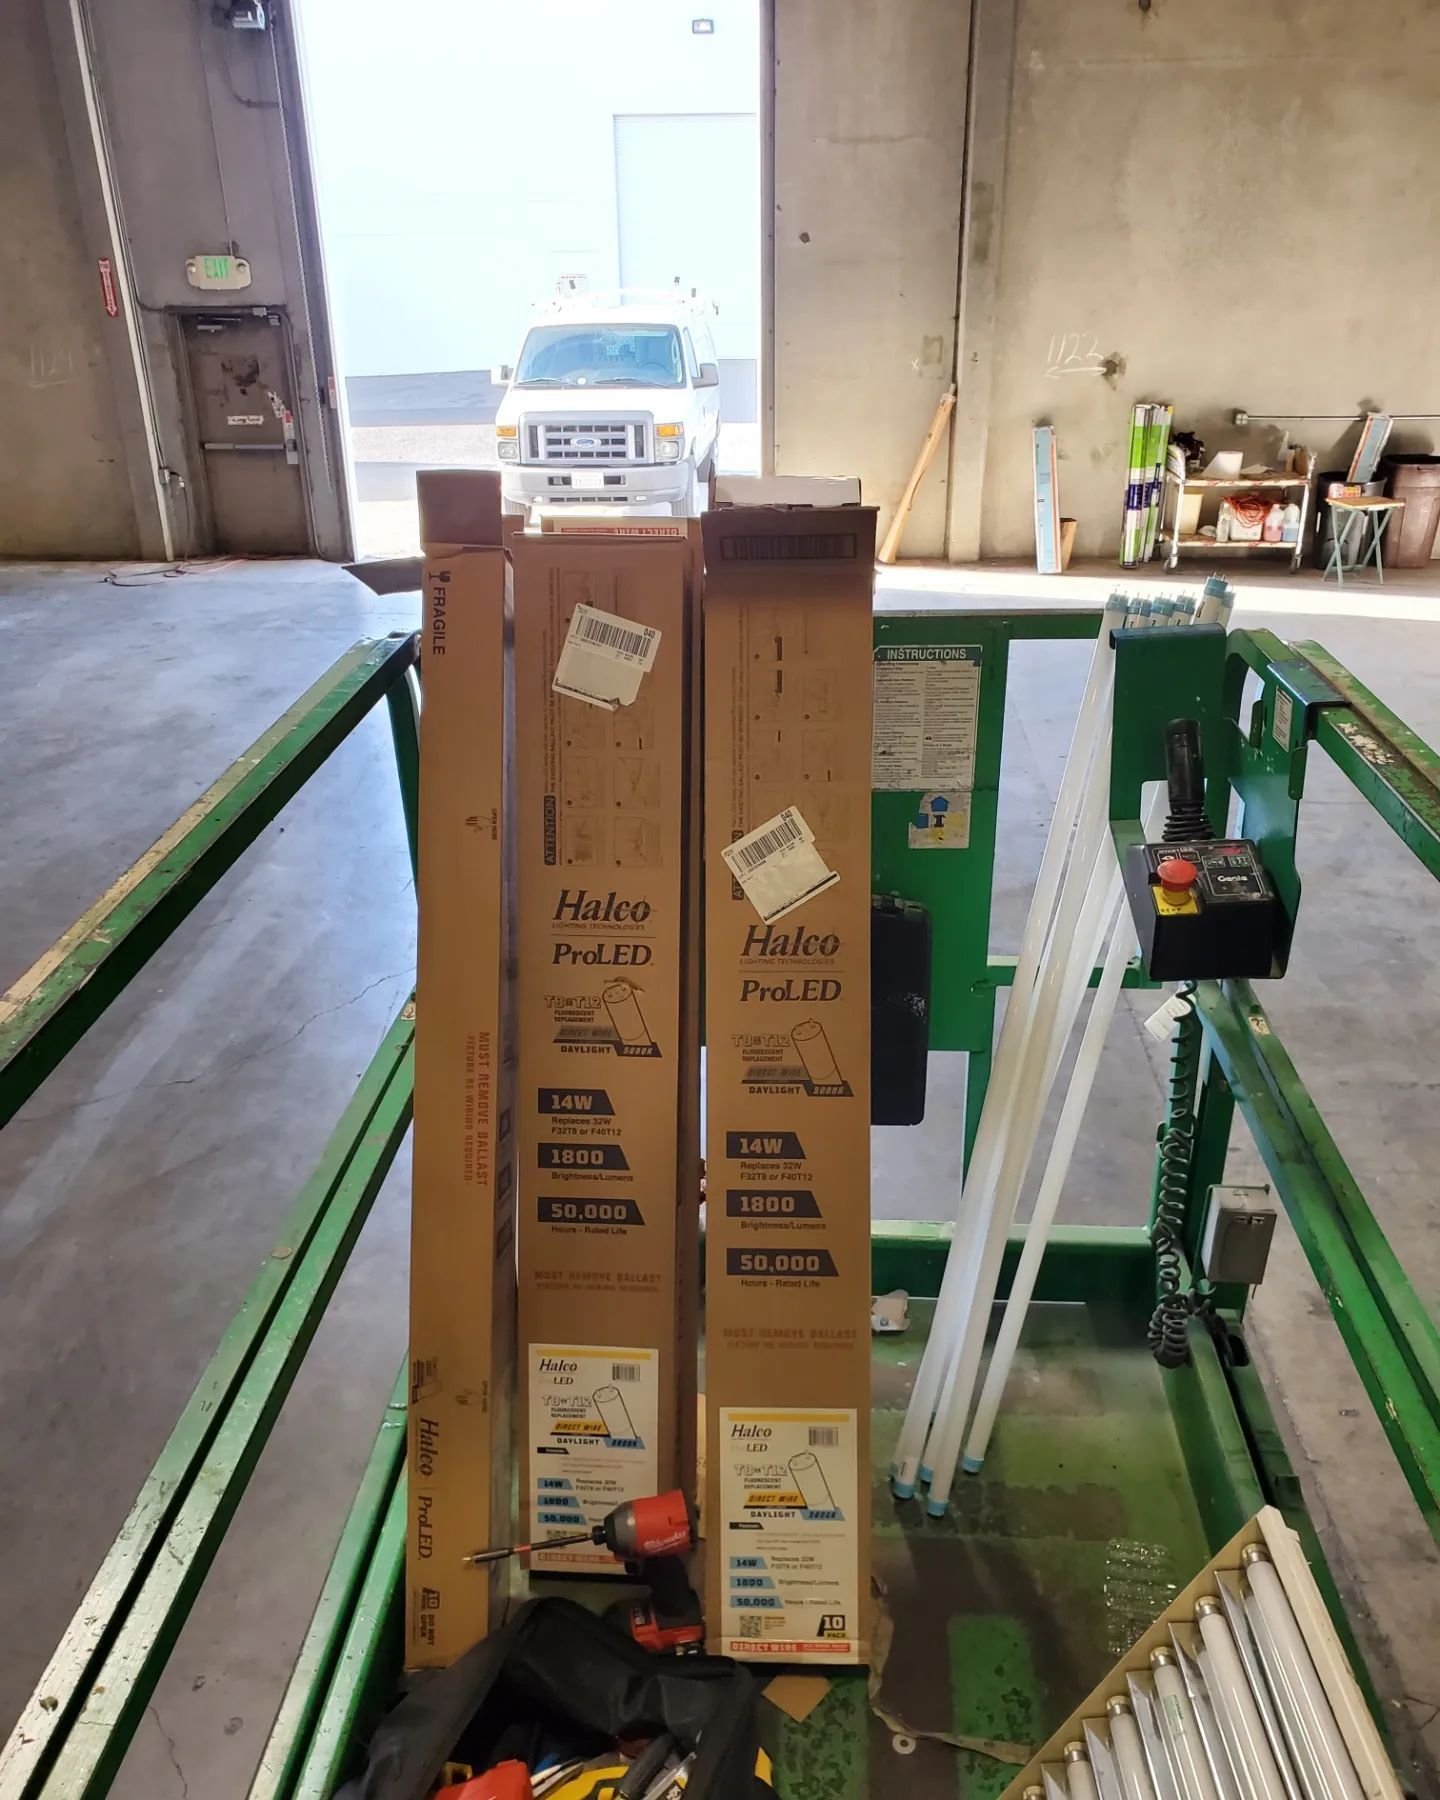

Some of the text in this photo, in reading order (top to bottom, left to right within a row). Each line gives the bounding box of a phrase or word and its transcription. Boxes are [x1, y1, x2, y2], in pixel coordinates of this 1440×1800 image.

[203, 257, 230, 279] EXIT
[1047, 331, 1104, 364] 1122
[432, 587, 446, 655] FRAGILE
[886, 648, 967, 660] INSTRUCTIONS
[545, 796, 555, 864] ATTENTION
[552, 889, 652, 922] Halco
[552, 922, 586, 930] LIGHTING
[740, 924, 840, 957] Halco
[552, 943, 652, 966] ProLED
[740, 979, 842, 1002] ProLED
[560, 1045, 612, 1054] DAYLIGHT
[748, 1086, 800, 1094] DAYLIGHT
[551, 1095, 593, 1110] 14W
[476, 1032, 490, 1186] MUST REMOVE BALLAST
[552, 1116, 612, 1126] Replaces 32W
[552, 1126, 577, 1135] F32T8
[591, 1128, 622, 1136] F40T12
[740, 1138, 782, 1154] 14W
[551, 1149, 604, 1165] 1800
[740, 1161, 780, 1171] Replaces
[552, 1172, 634, 1182] Brightness/Lumens
[740, 1172, 767, 1180] F32T8
[780, 1173, 813, 1181] F40T12
[740, 1196, 795, 1212] 1800
[551, 1204, 627, 1220] 50,000
[551, 1226, 577, 1234] Hours
[584, 1226, 609, 1234] Rated
[611, 1226, 627, 1235] Life
[740, 1221, 826, 1232] Brightness/Lumens
[740, 1254, 820, 1273] 50,000
[775, 1280, 801, 1288] Rated
[803, 1280, 820, 1288] Life
[539, 1358, 578, 1372] Halco
[731, 1424, 772, 1438] Halco
[418, 1416, 439, 1558] Halco ProLED
[544, 1480, 563, 1488] 14W
[748, 1494, 775, 1502] DIRECT
[544, 1514, 580, 1523] 50,000
[736, 1558, 757, 1567] 14W
[736, 1578, 763, 1586] 1800
[737, 1598, 775, 1607] 50,000
[428, 1614, 435, 1626] DO
[823, 1617, 843, 1629] 10
[731, 1642, 768, 1651] DIRECT
[770, 1643, 796, 1652] WIRE
